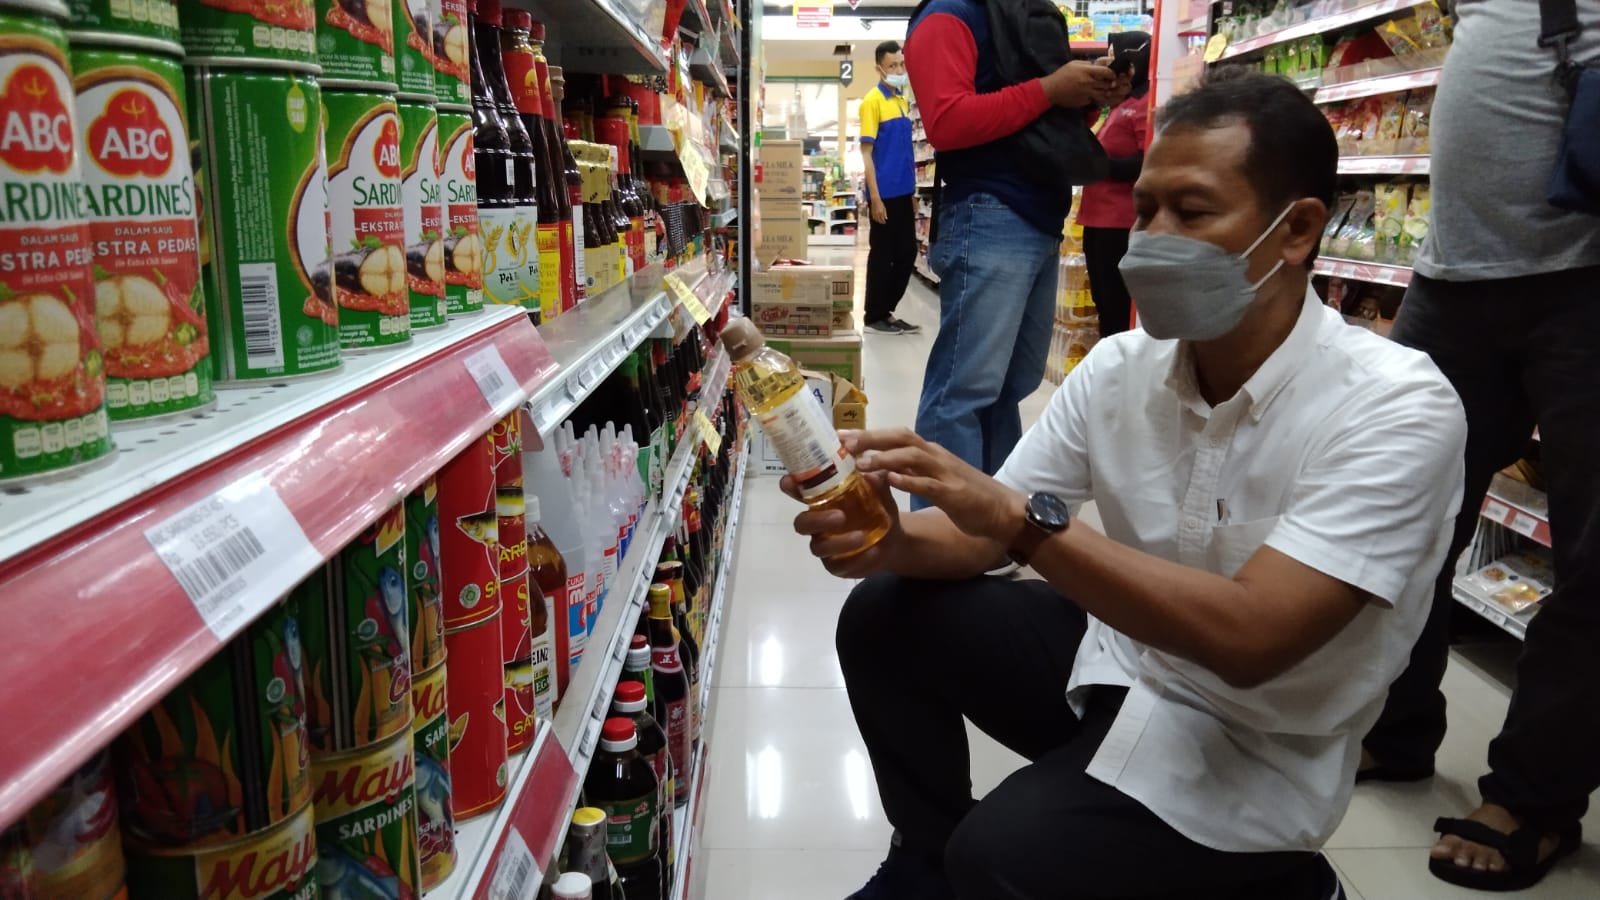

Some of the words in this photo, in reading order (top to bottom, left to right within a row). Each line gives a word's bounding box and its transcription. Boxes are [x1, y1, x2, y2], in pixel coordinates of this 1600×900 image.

[841, 63, 852, 79] 2
[1, 111, 71, 152] ABC
[100, 127, 169, 161] ABC
[0, 181, 87, 222] RDINE
[114, 226, 150, 236] DALAM
[152, 225, 173, 234] SAUS
[1, 250, 60, 272] STRA
[97, 240, 151, 256] STRA
[157, 238, 196, 253] PEDAS
[339, 795, 413, 840] SARDINES
